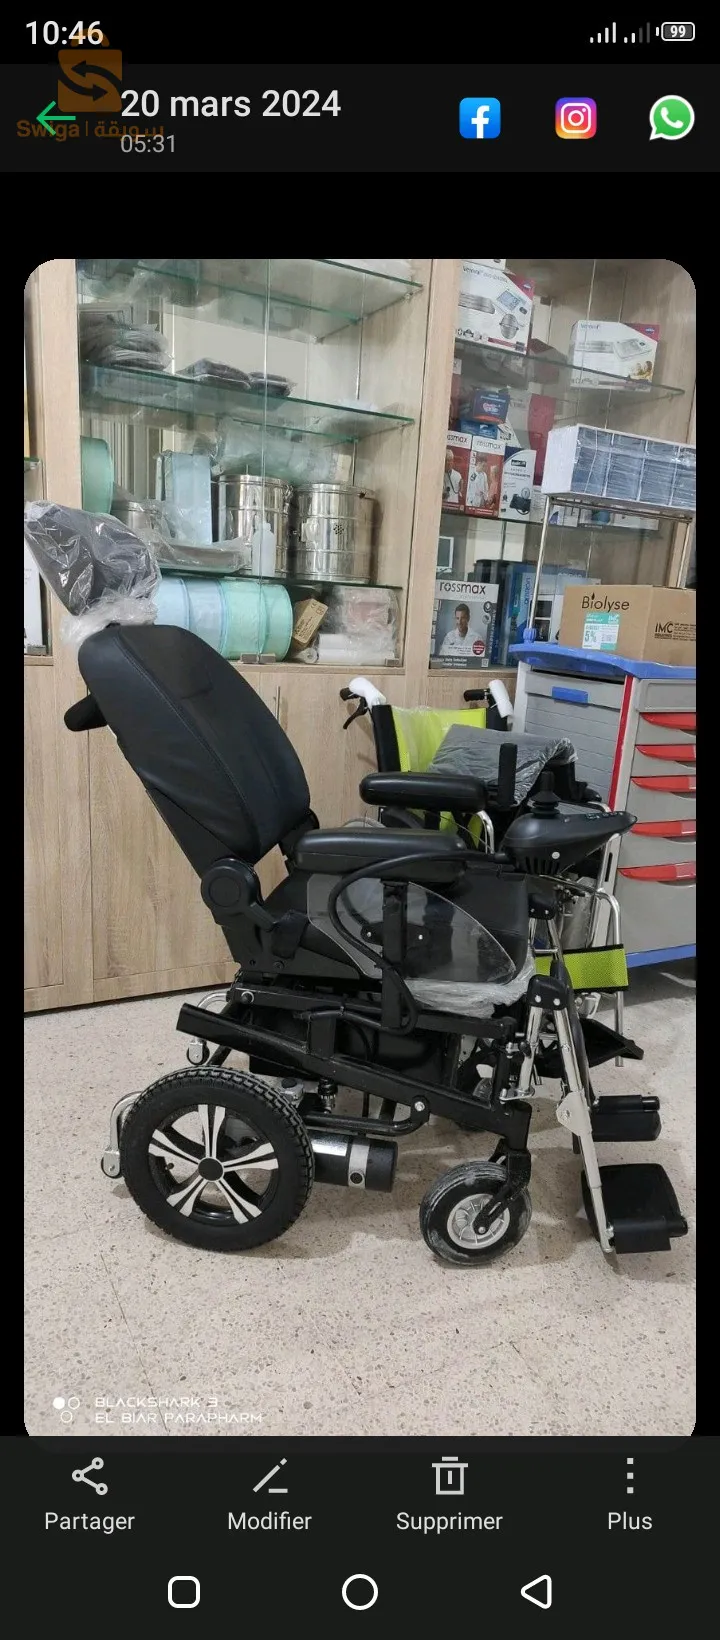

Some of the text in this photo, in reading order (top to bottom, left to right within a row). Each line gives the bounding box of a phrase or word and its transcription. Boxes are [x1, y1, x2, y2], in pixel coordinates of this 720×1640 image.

[26, 20, 104, 45] 10:46
[670, 24, 686, 38] 99
[121, 89, 342, 117] 20 mars 2024
[120, 134, 174, 153] 05:31
[439, 581, 487, 595] rossmax
[581, 592, 630, 613] Biolyse
[654, 621, 674, 633] IMC
[45, 1511, 136, 1535] Partager
[228, 1510, 313, 1531] Modifier
[396, 1511, 504, 1535] Supprimer
[608, 1511, 654, 1531] Plus
